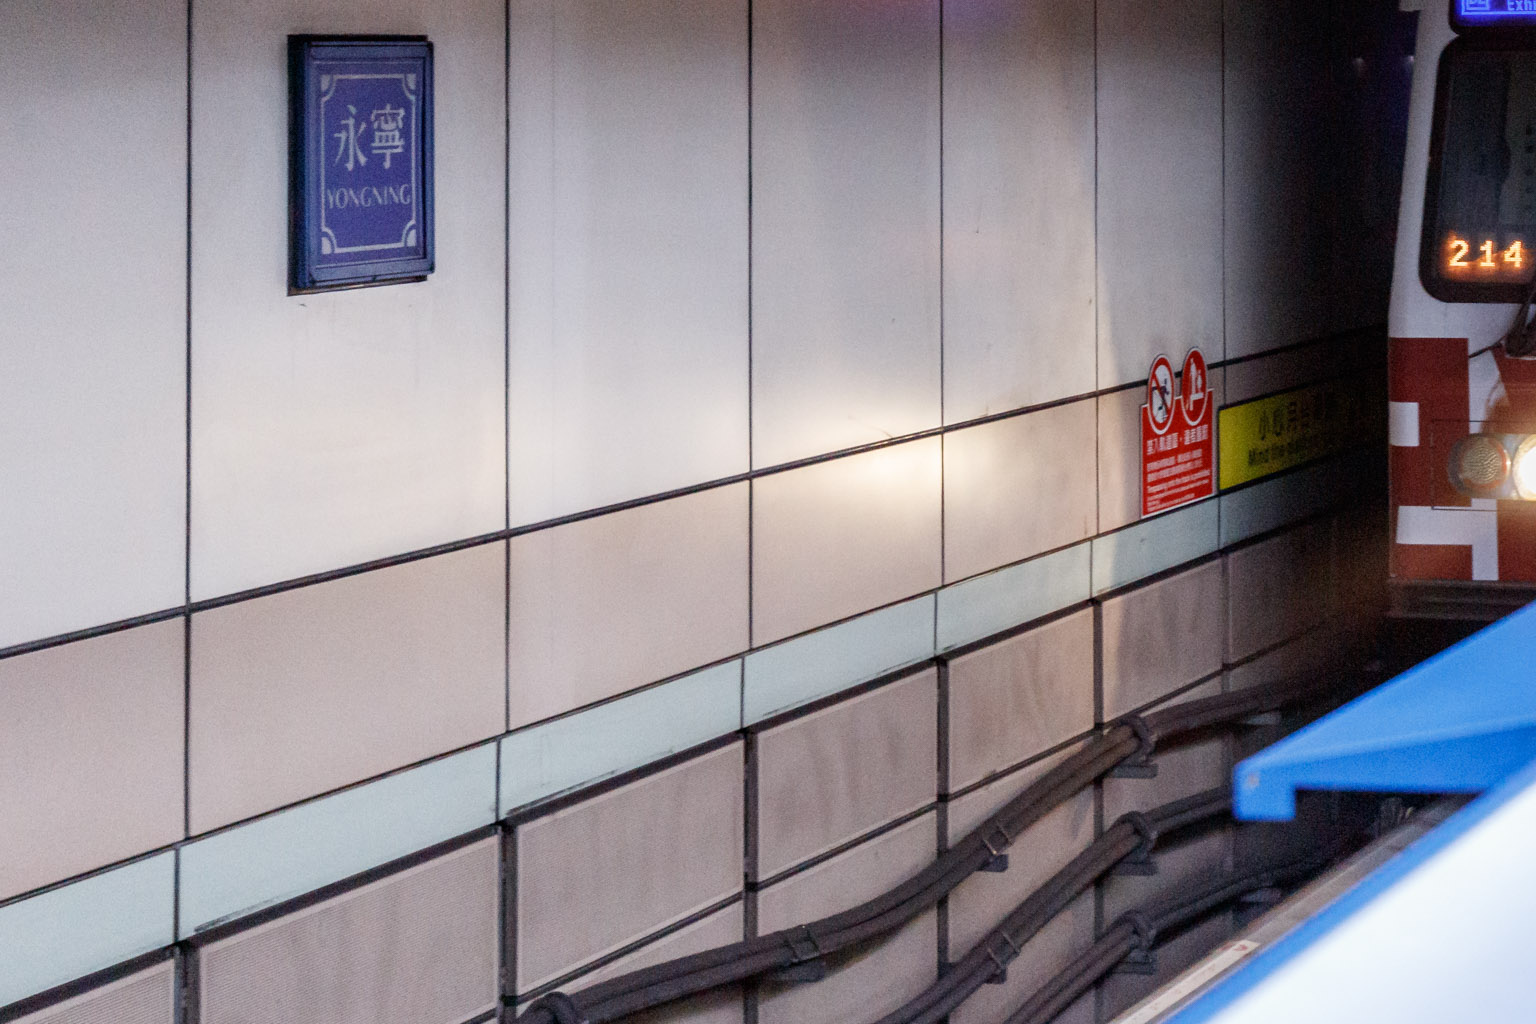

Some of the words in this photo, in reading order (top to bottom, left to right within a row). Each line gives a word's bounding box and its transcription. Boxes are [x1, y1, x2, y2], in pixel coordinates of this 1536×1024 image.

[333, 103, 406, 171] 永寧
[327, 183, 412, 209] YONGNING
[1448, 239, 1523, 268] 214
